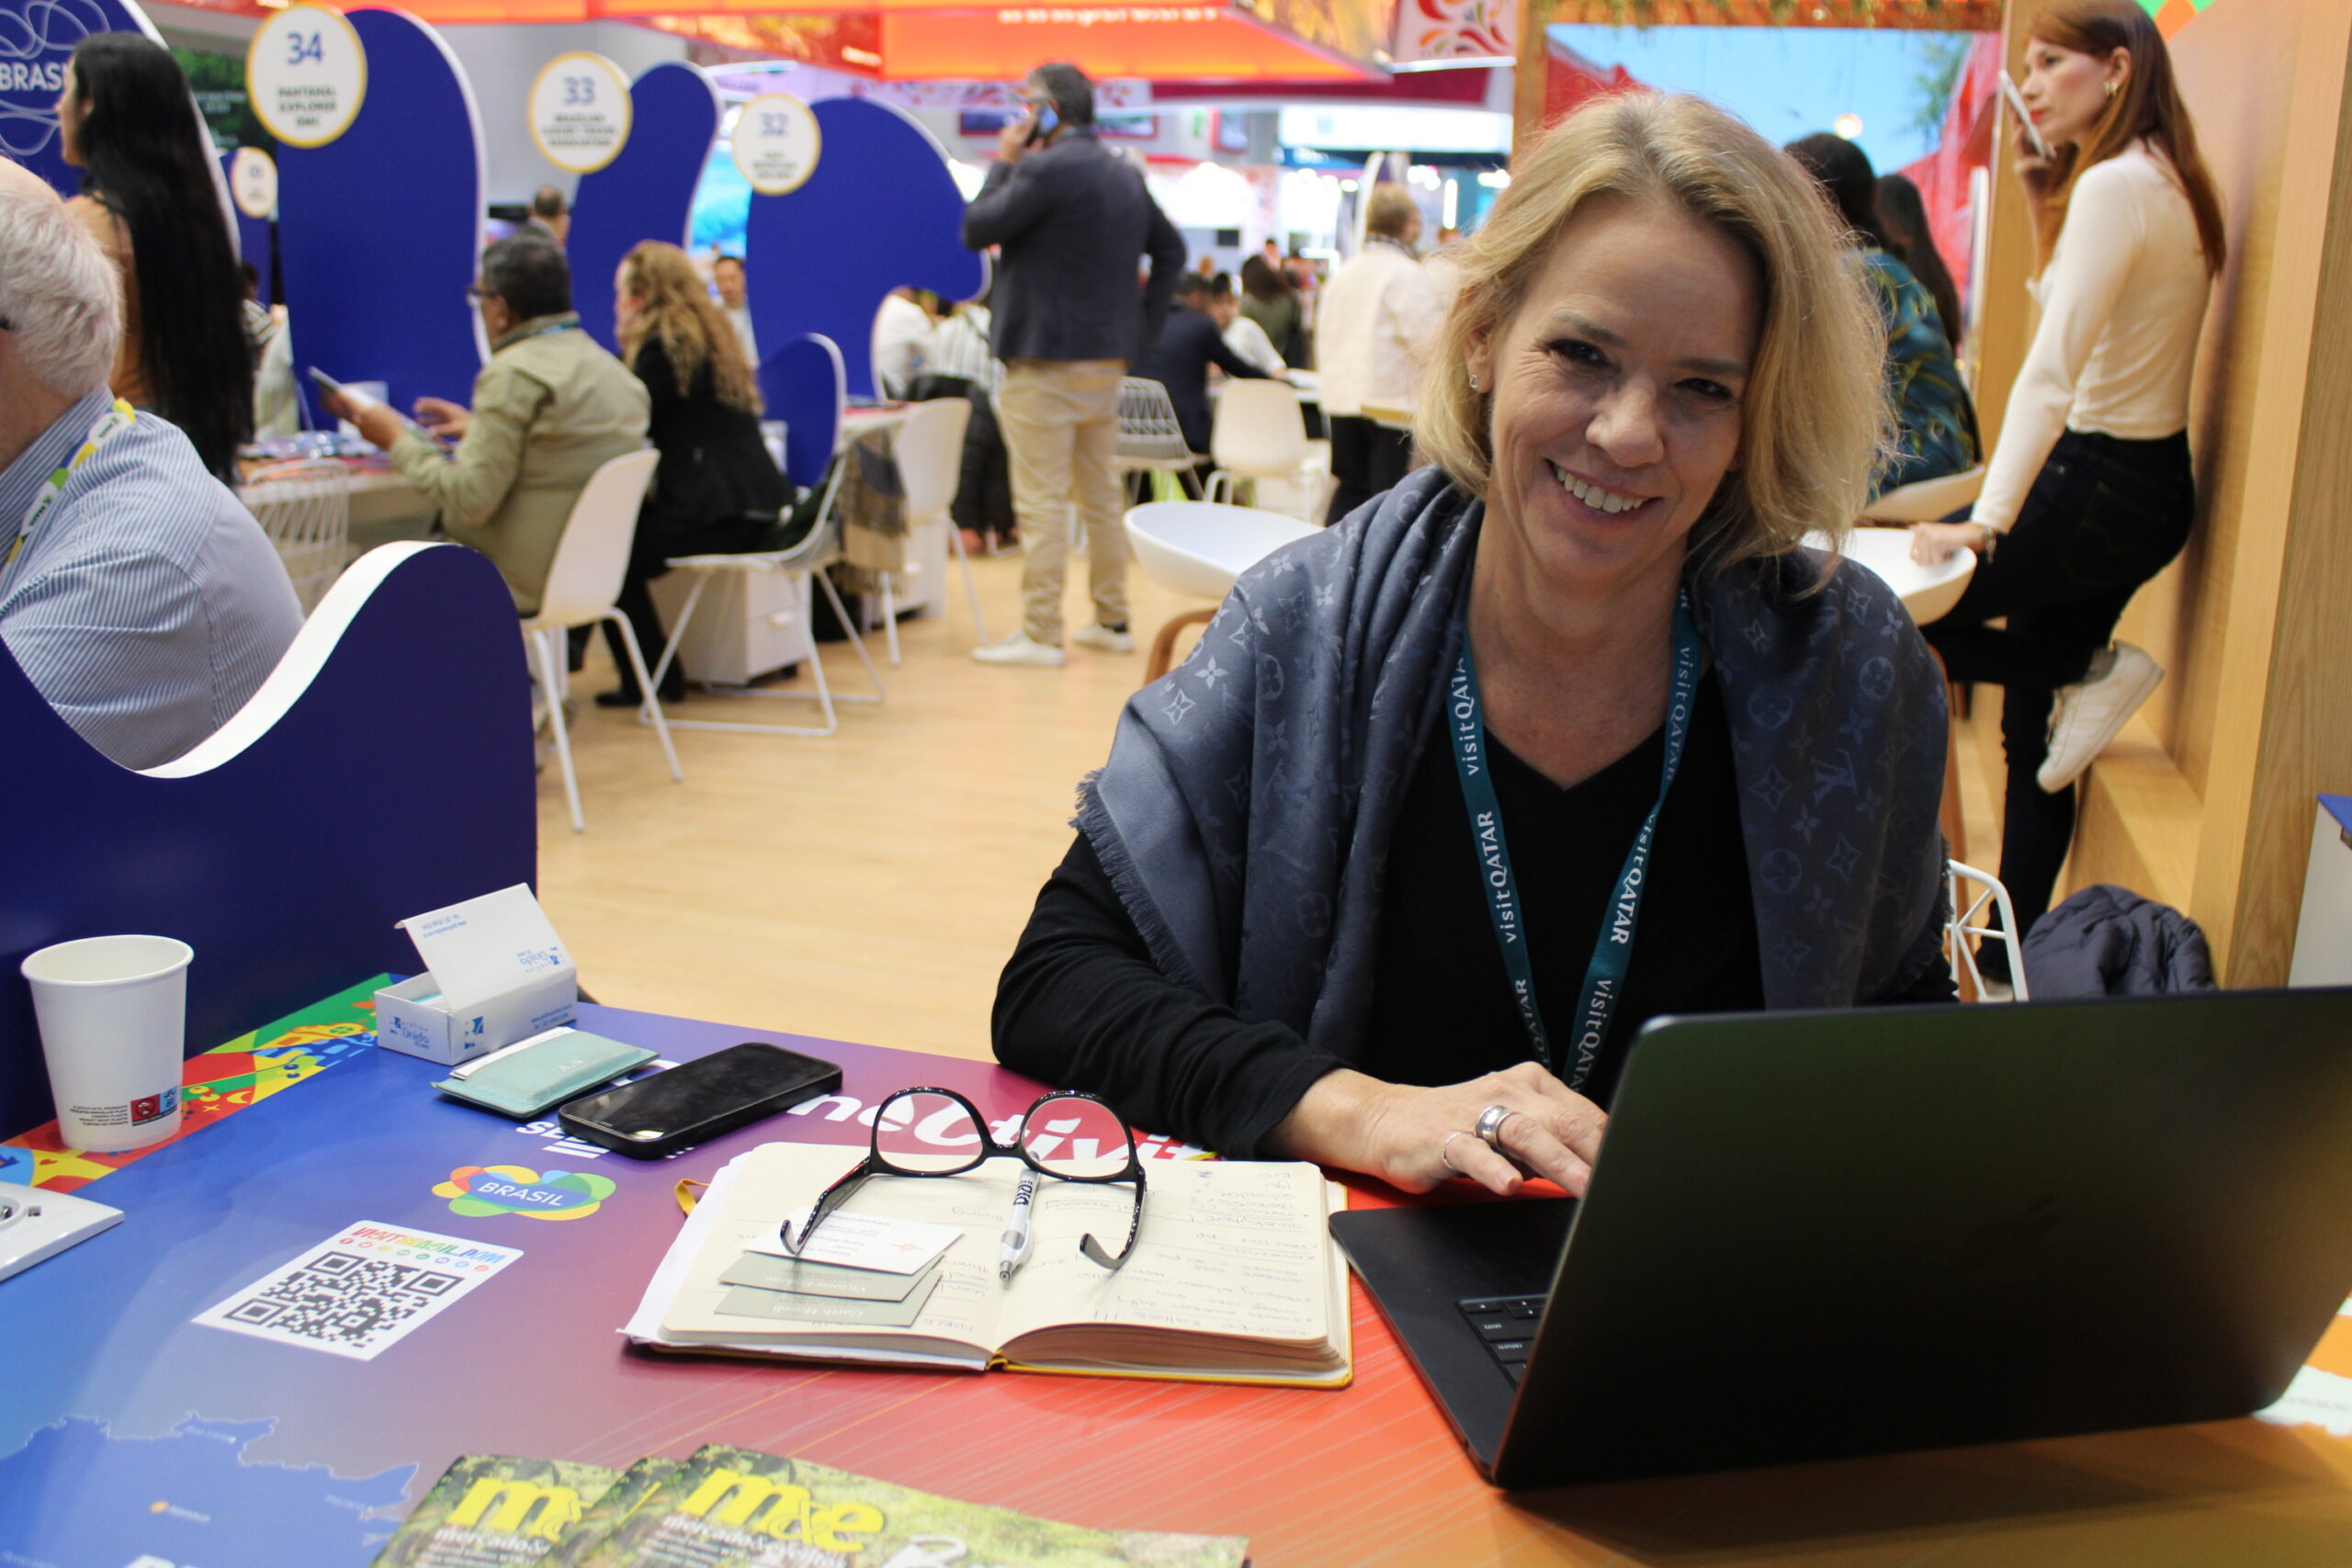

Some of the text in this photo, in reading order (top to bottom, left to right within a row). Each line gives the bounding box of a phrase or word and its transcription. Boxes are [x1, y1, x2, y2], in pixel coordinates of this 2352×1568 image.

[286, 31, 323, 64] 34
[0, 62, 71, 91] BRASI
[563, 76, 596, 104] 33
[1452, 654, 1480, 776] visitQATA
[1476, 810, 1518, 944] visitQATAR
[1569, 979, 1613, 1092] visitQATA
[477, 1181, 564, 1206] BRASIL
